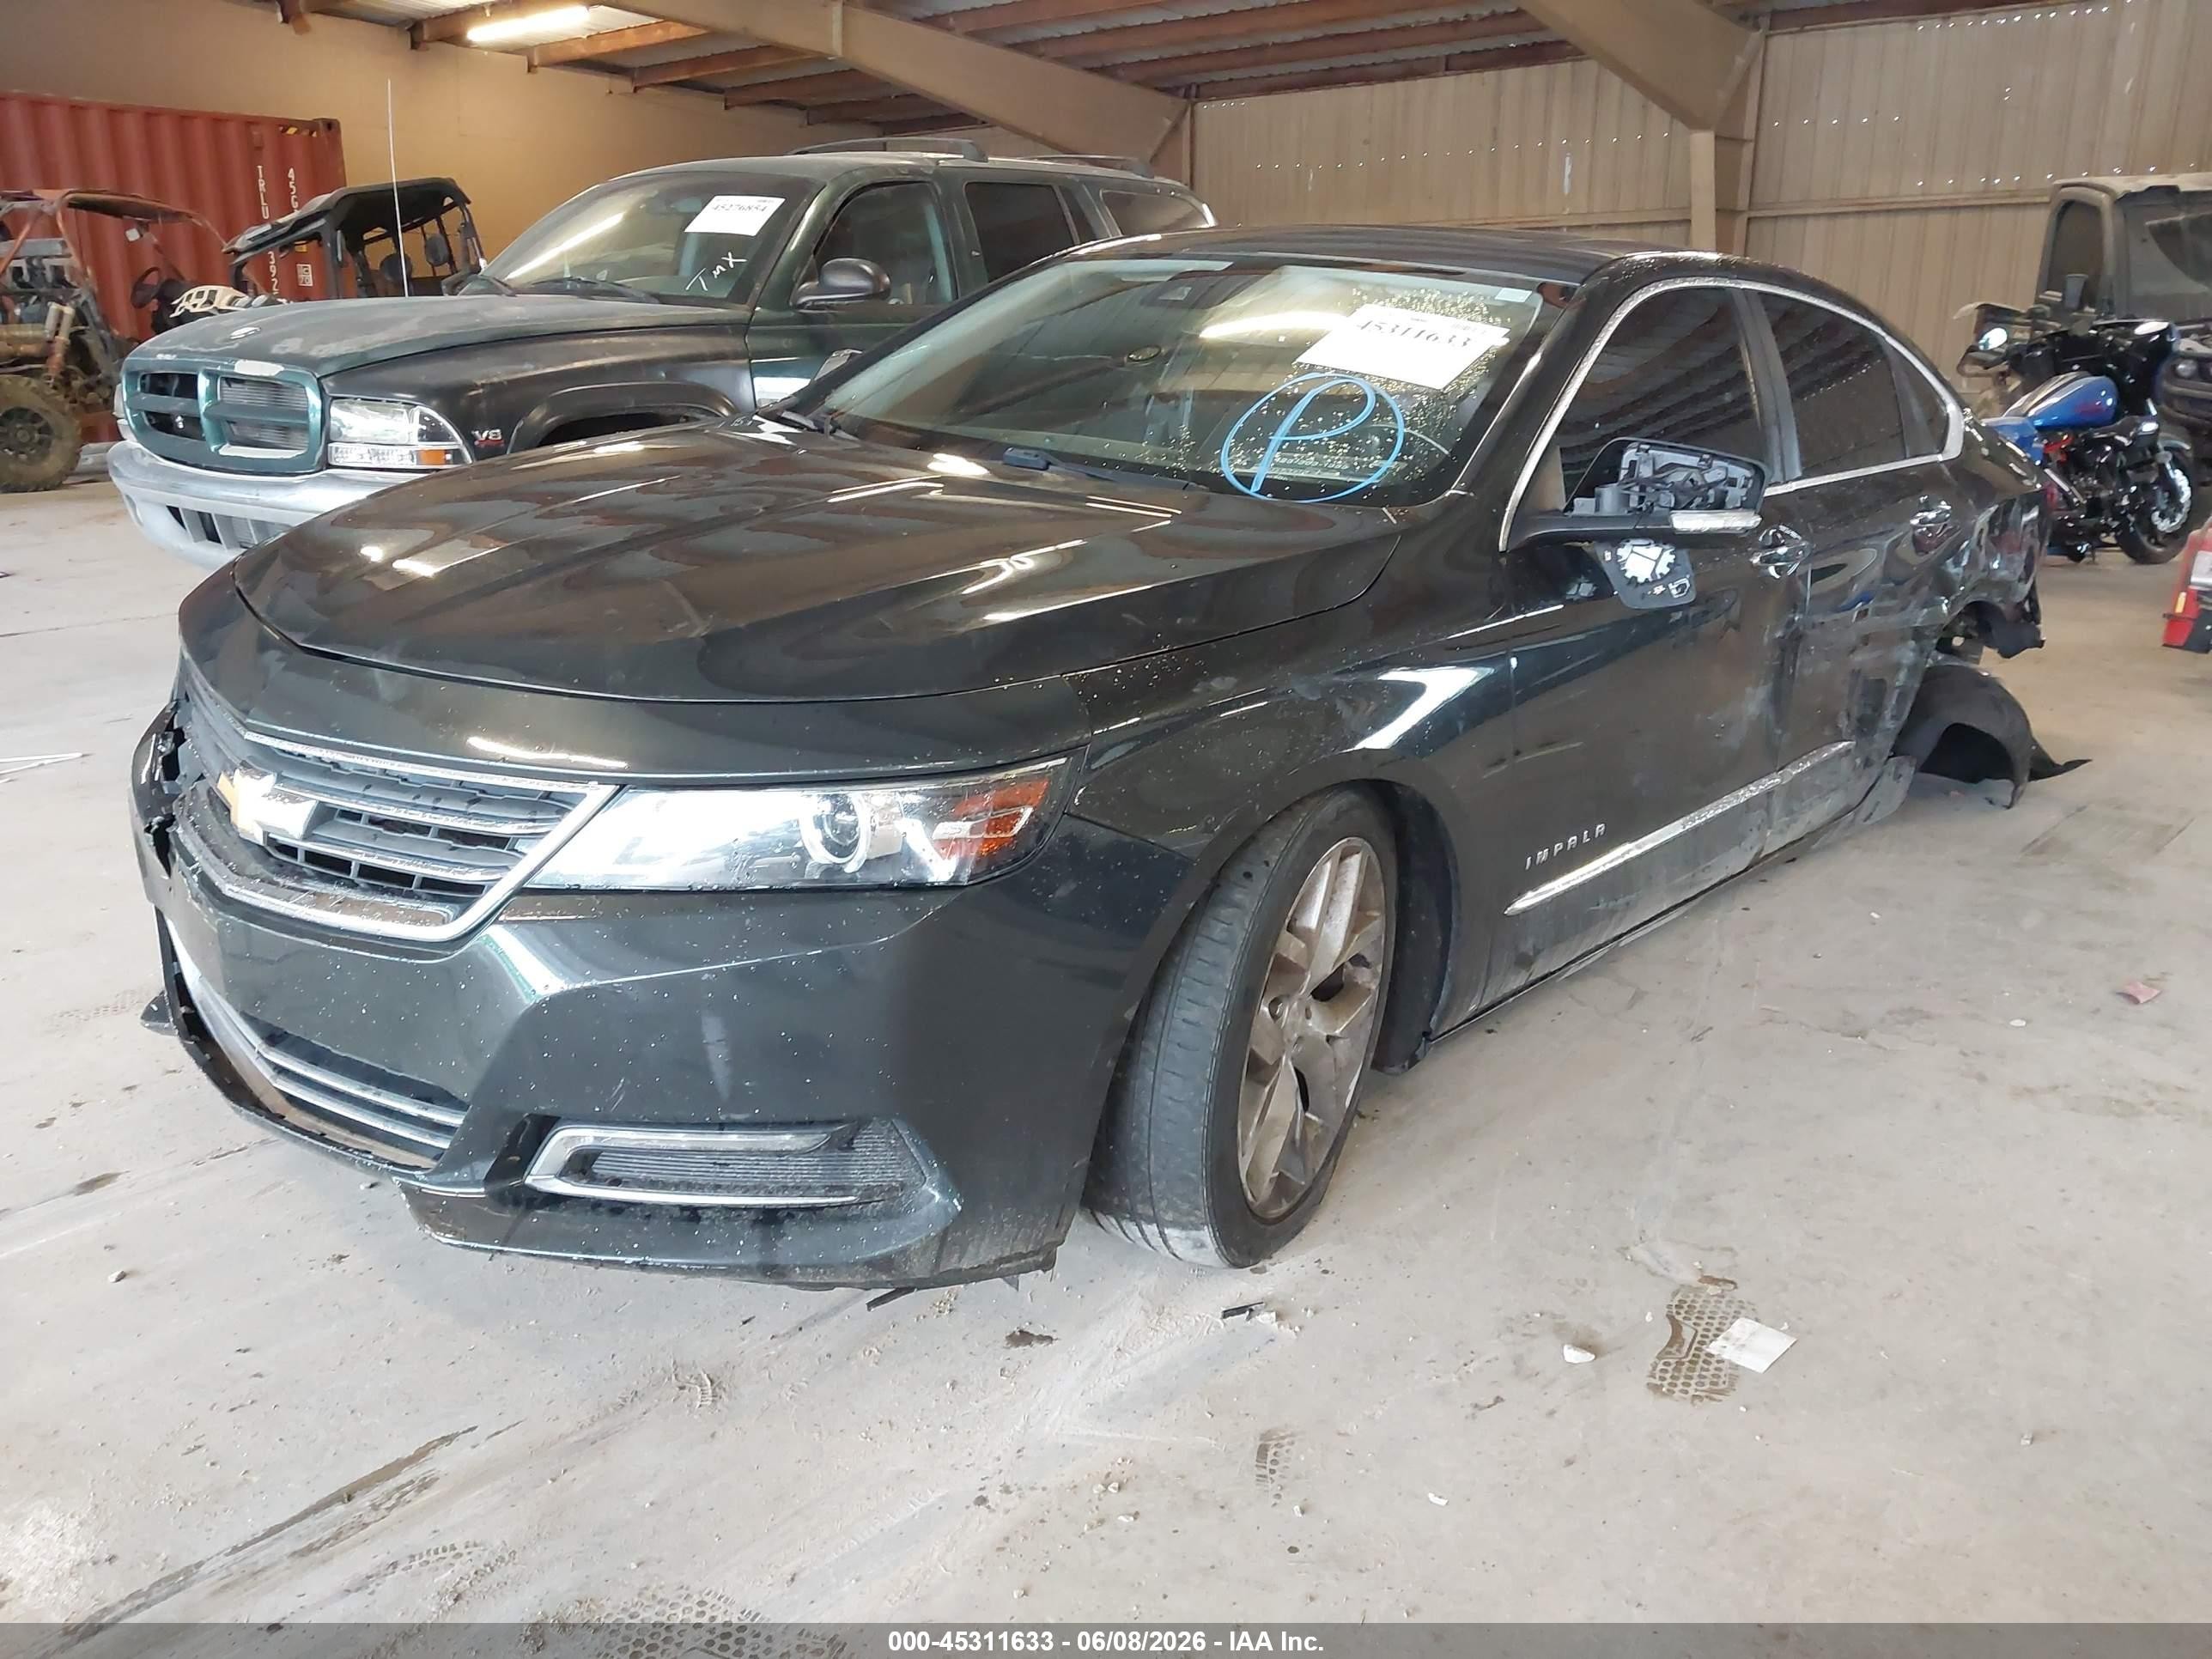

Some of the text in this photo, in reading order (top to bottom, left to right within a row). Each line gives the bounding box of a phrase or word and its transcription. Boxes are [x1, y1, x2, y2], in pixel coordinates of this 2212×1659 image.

[257, 165, 270, 219] TRLU
[1250, 378, 1376, 494] P
[1524, 823, 1606, 871] IMPALA
